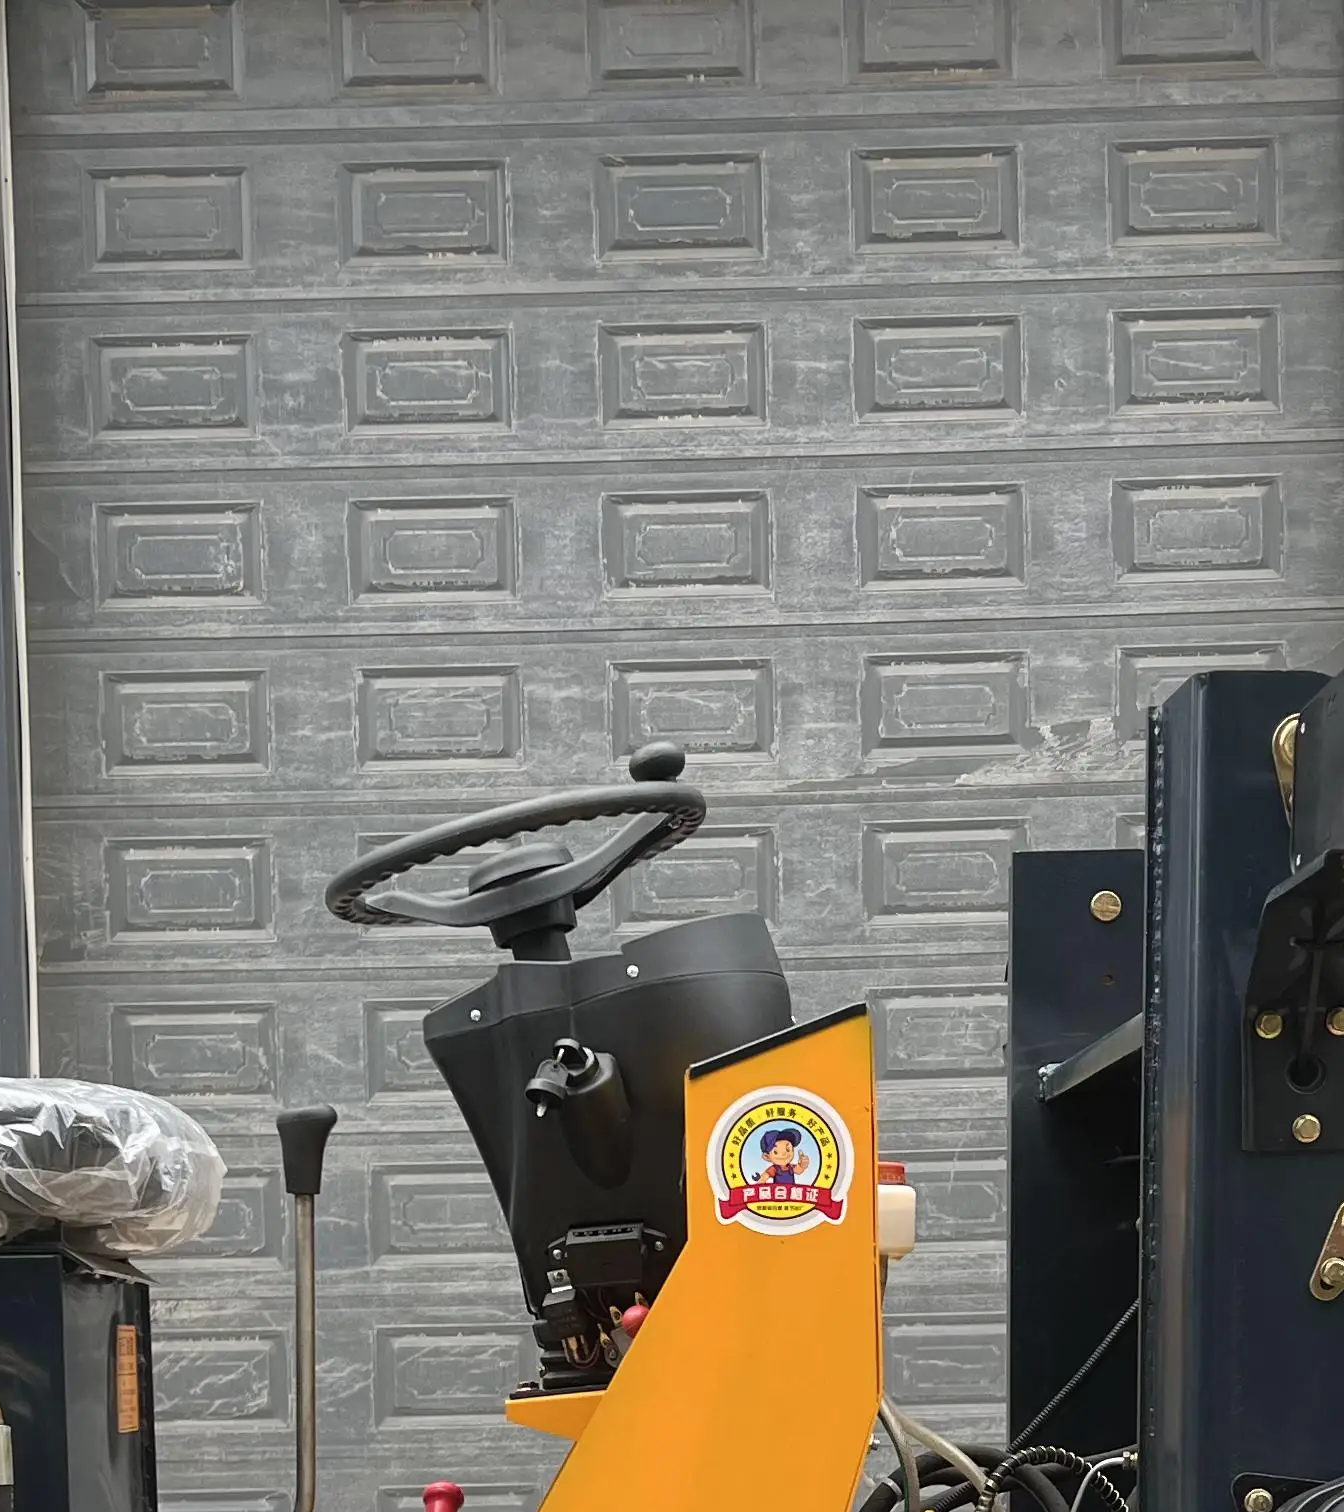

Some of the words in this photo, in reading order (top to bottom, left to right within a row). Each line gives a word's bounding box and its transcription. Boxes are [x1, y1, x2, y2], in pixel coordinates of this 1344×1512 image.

[742, 1185, 819, 1201] 产品合格证
